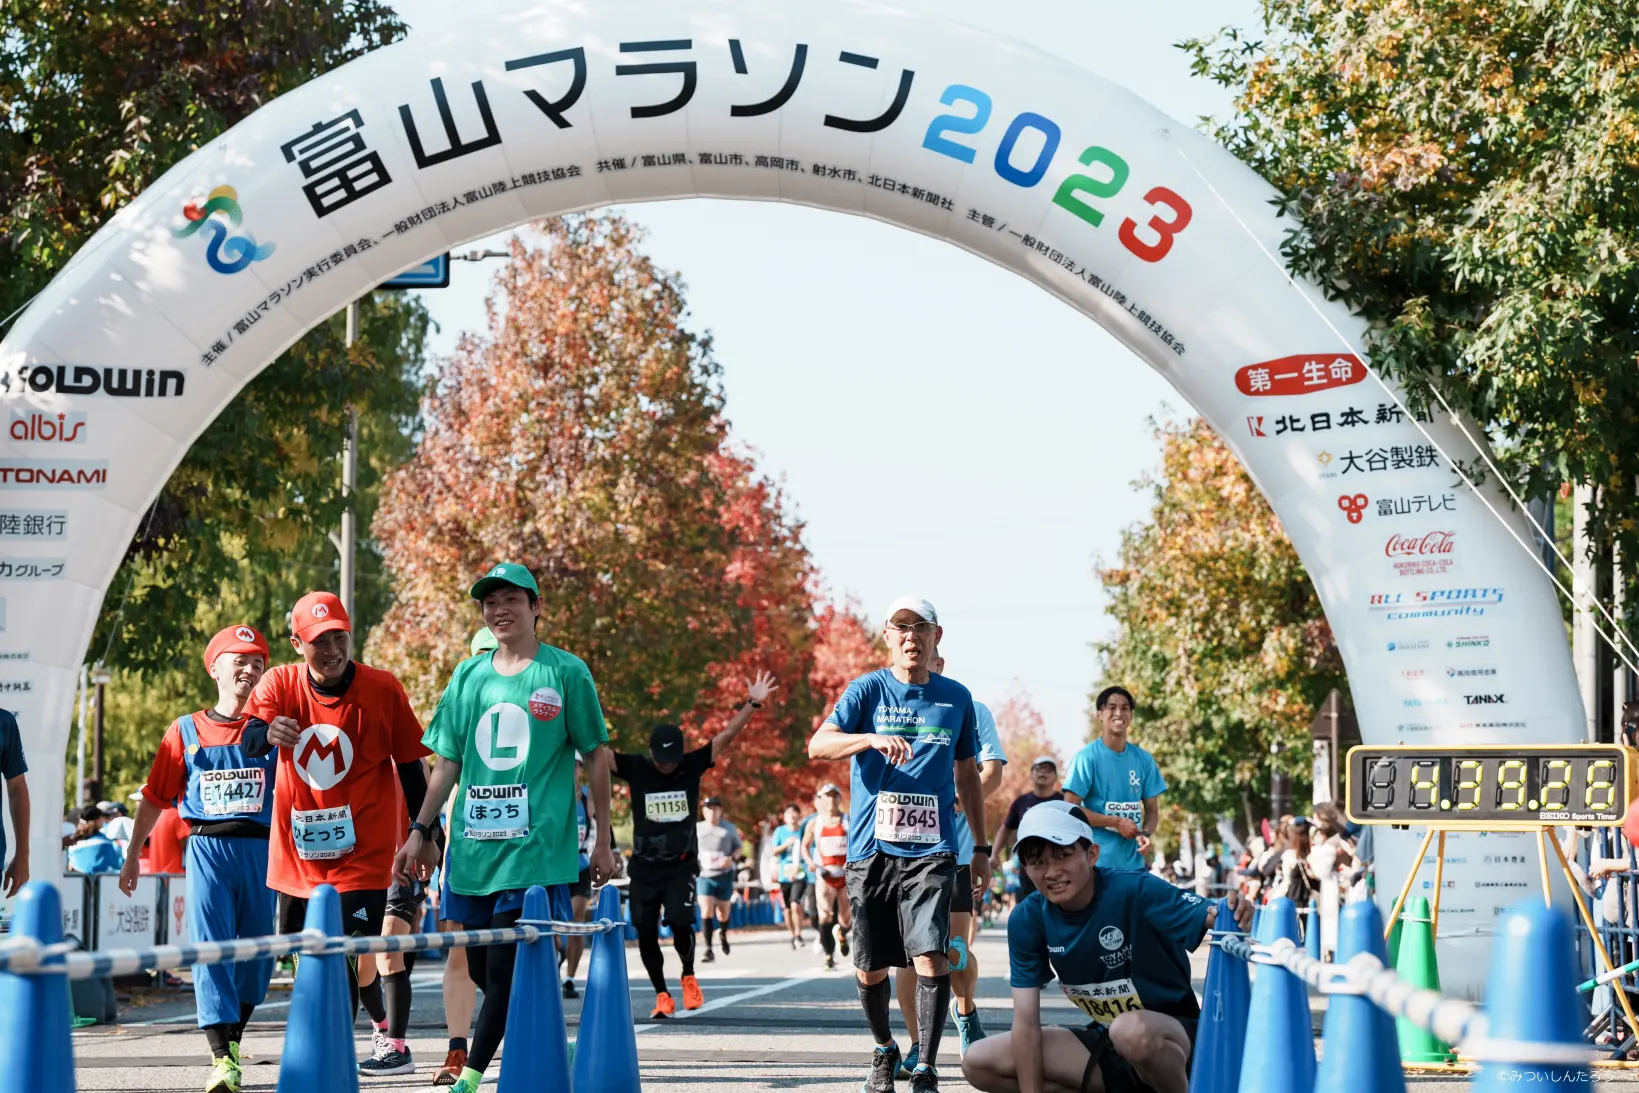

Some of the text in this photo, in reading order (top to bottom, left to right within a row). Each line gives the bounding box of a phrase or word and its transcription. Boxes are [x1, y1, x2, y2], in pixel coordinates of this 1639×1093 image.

[16, 365, 185, 397] OLDWIN
[1247, 357, 1353, 392] 第一生命
[10, 412, 85, 442] albis
[1340, 445, 1440, 474] 大谷製鉄
[0, 468, 107, 484] TONAMI
[1376, 494, 1456, 516] 富山テレビ
[1385, 530, 1457, 558] Coca-Cola
[238, 629, 253, 639] M
[1455, 640, 1490, 648] SHINKO
[877, 706, 912, 714] TOYAMA
[877, 716, 926, 724] MARATHON
[490, 713, 518, 759] L
[297, 731, 346, 776] M
[881, 794, 935, 807] GOLDWIN
[1540, 812, 1617, 821] SEIKO Sports Timer
[1073, 997, 1140, 1018] 18416
